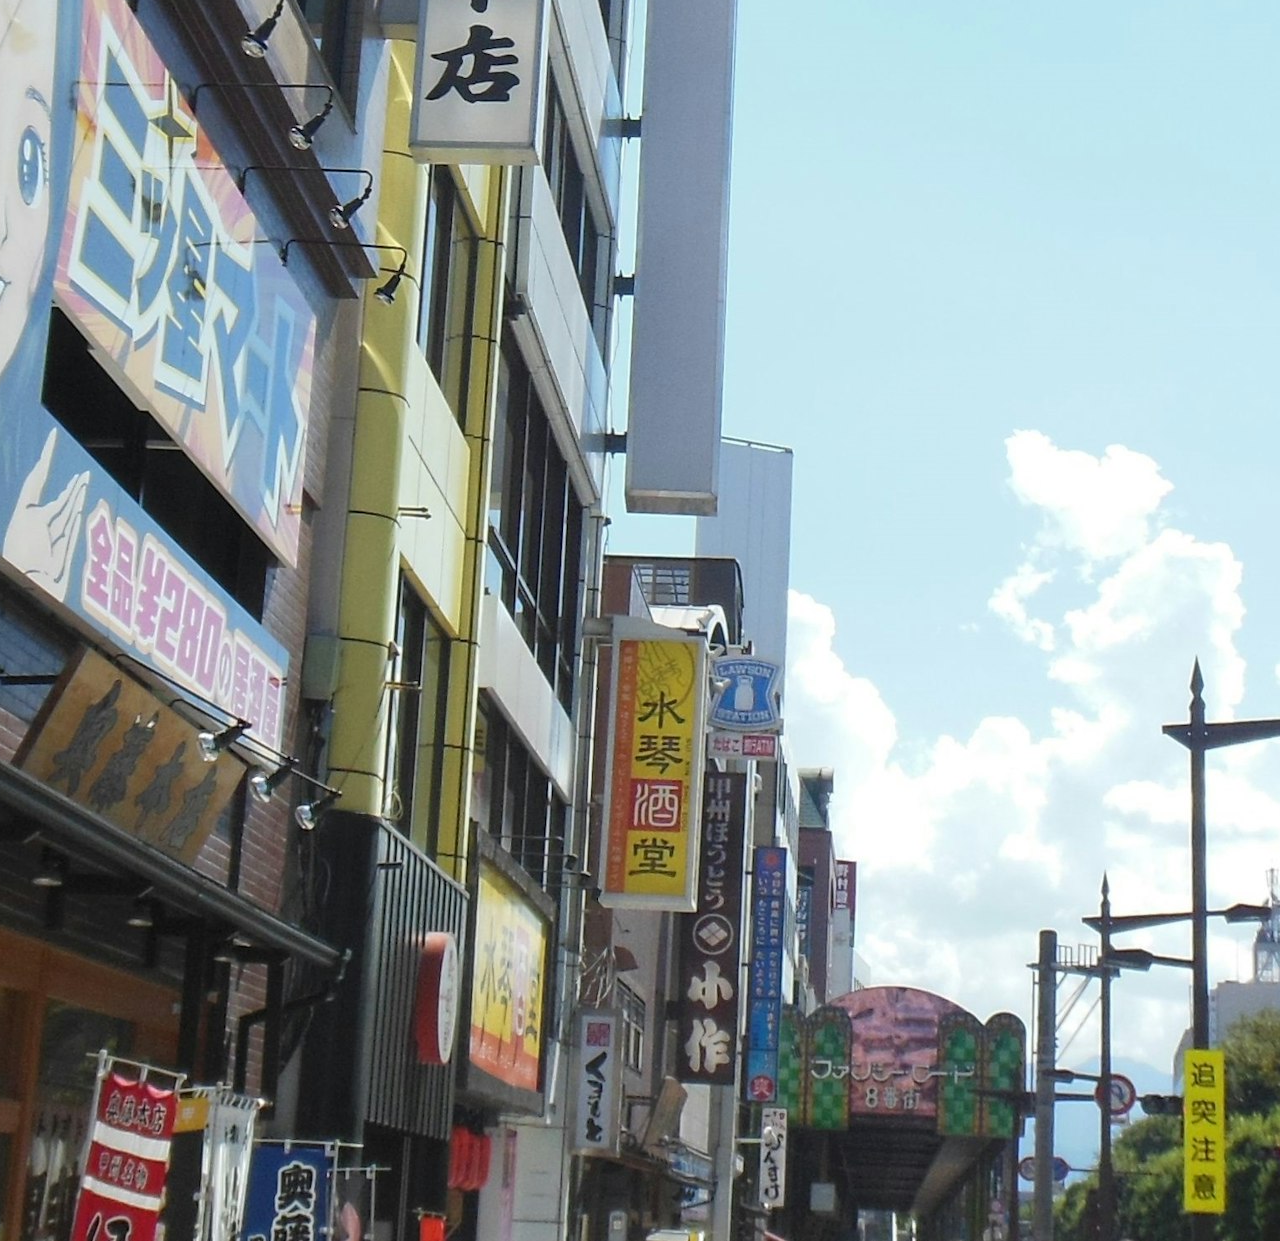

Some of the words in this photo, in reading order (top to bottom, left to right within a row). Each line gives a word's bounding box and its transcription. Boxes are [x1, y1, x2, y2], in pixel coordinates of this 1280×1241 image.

[717, 708, 771, 723] STATION
[718, 664, 772, 679] LAWSON
[628, 691, 687, 878] 水琴酒堂
[704, 778, 732, 910] 甲州ほうとう
[684, 960, 734, 1074] 小作
[105, 1088, 167, 1136] 奥藤本店
[1191, 1061, 1217, 1201] 追突注意
